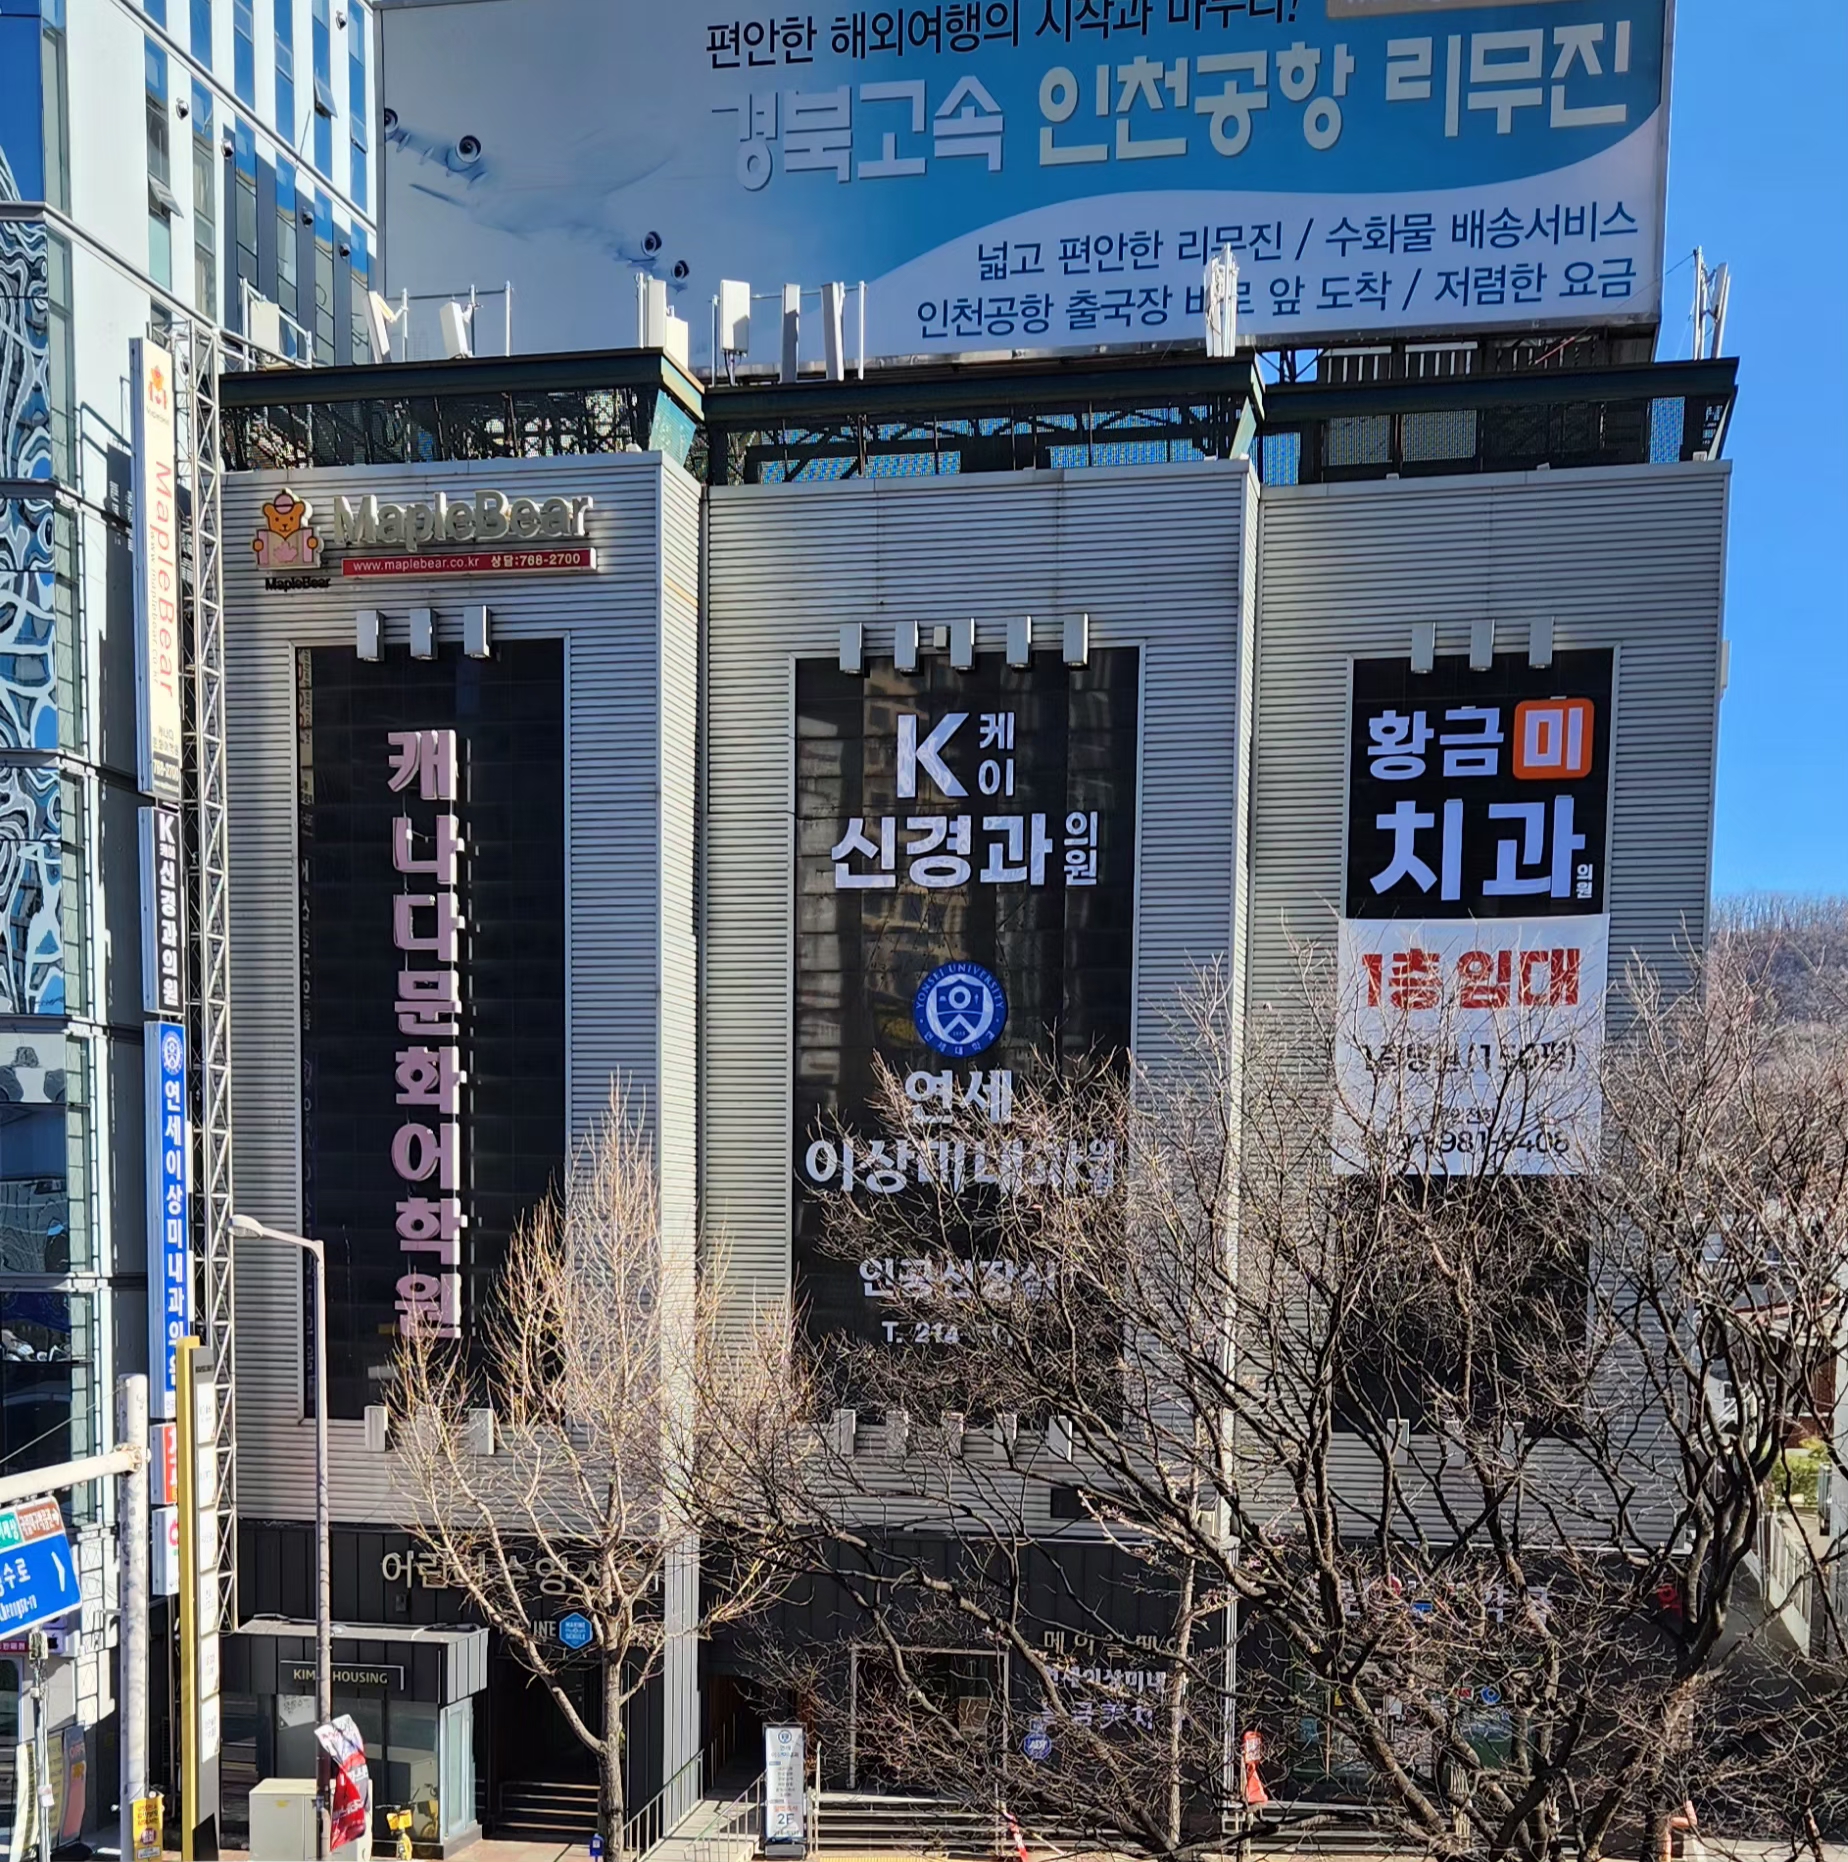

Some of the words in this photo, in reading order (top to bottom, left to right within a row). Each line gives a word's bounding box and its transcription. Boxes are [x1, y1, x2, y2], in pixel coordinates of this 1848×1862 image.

[706, 16, 818, 69] 편안한
[831, 0, 1019, 59] 해외여행의
[709, 75, 1004, 192] 경북고속
[1039, 41, 1355, 166] 인천공항
[1386, 20, 1631, 137] 리무진
[978, 240, 1045, 281] 넓고
[1058, 229, 1163, 275] 편안한
[1178, 221, 1282, 266] 리무진
[1325, 212, 1436, 258] 수화물
[1452, 201, 1639, 250] 배송서비스
[917, 292, 1054, 339] 인천공항
[1065, 284, 1173, 331] 출국장
[1269, 276, 1305, 316] 앞
[1316, 269, 1392, 312] 도착
[1434, 261, 1548, 308] 저렴한
[1559, 257, 1637, 299] 요금
[333, 490, 595, 552] MapleBear
[150, 460, 175, 698] MapleBear
[353, 556, 480, 572] www.maplebear.co.kr
[897, 712, 970, 798] K
[978, 711, 1015, 797] 케이
[1367, 706, 1582, 780] 황금미
[831, 813, 1053, 890] 신경과
[1064, 811, 1098, 886] 의원
[1369, 795, 1586, 901] 치과
[1576, 863, 1593, 899] 의원
[916, 968, 944, 1009] YONSEI
[948, 963, 1005, 1009] UNIVERSITY
[387, 729, 467, 1339] 캐나다문화어학원
[905, 1069, 1012, 1125] 연세
[0, 1557, 31, 1598] 수로
[332, 1670, 388, 1684] HOUSING
